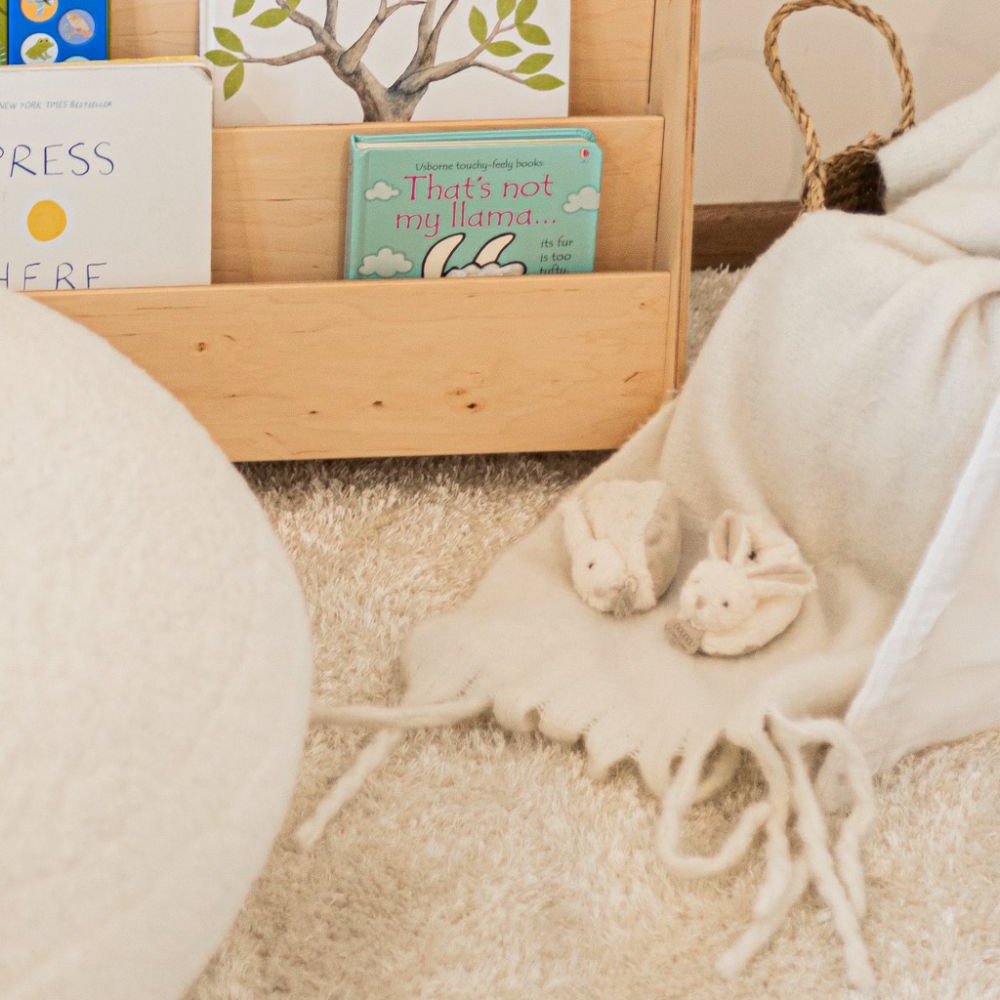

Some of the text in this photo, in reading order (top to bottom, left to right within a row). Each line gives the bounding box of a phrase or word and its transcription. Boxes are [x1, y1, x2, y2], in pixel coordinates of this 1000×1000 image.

[20, 101, 42, 109] YORK
[46, 100, 68, 109] TIMES
[415, 158, 543, 172] Usborne touchy-feely books
[403, 173, 553, 200] That's not
[396, 200, 556, 238] my llama...
[540, 236, 573, 248] its fur
[540, 251, 572, 262] is too
